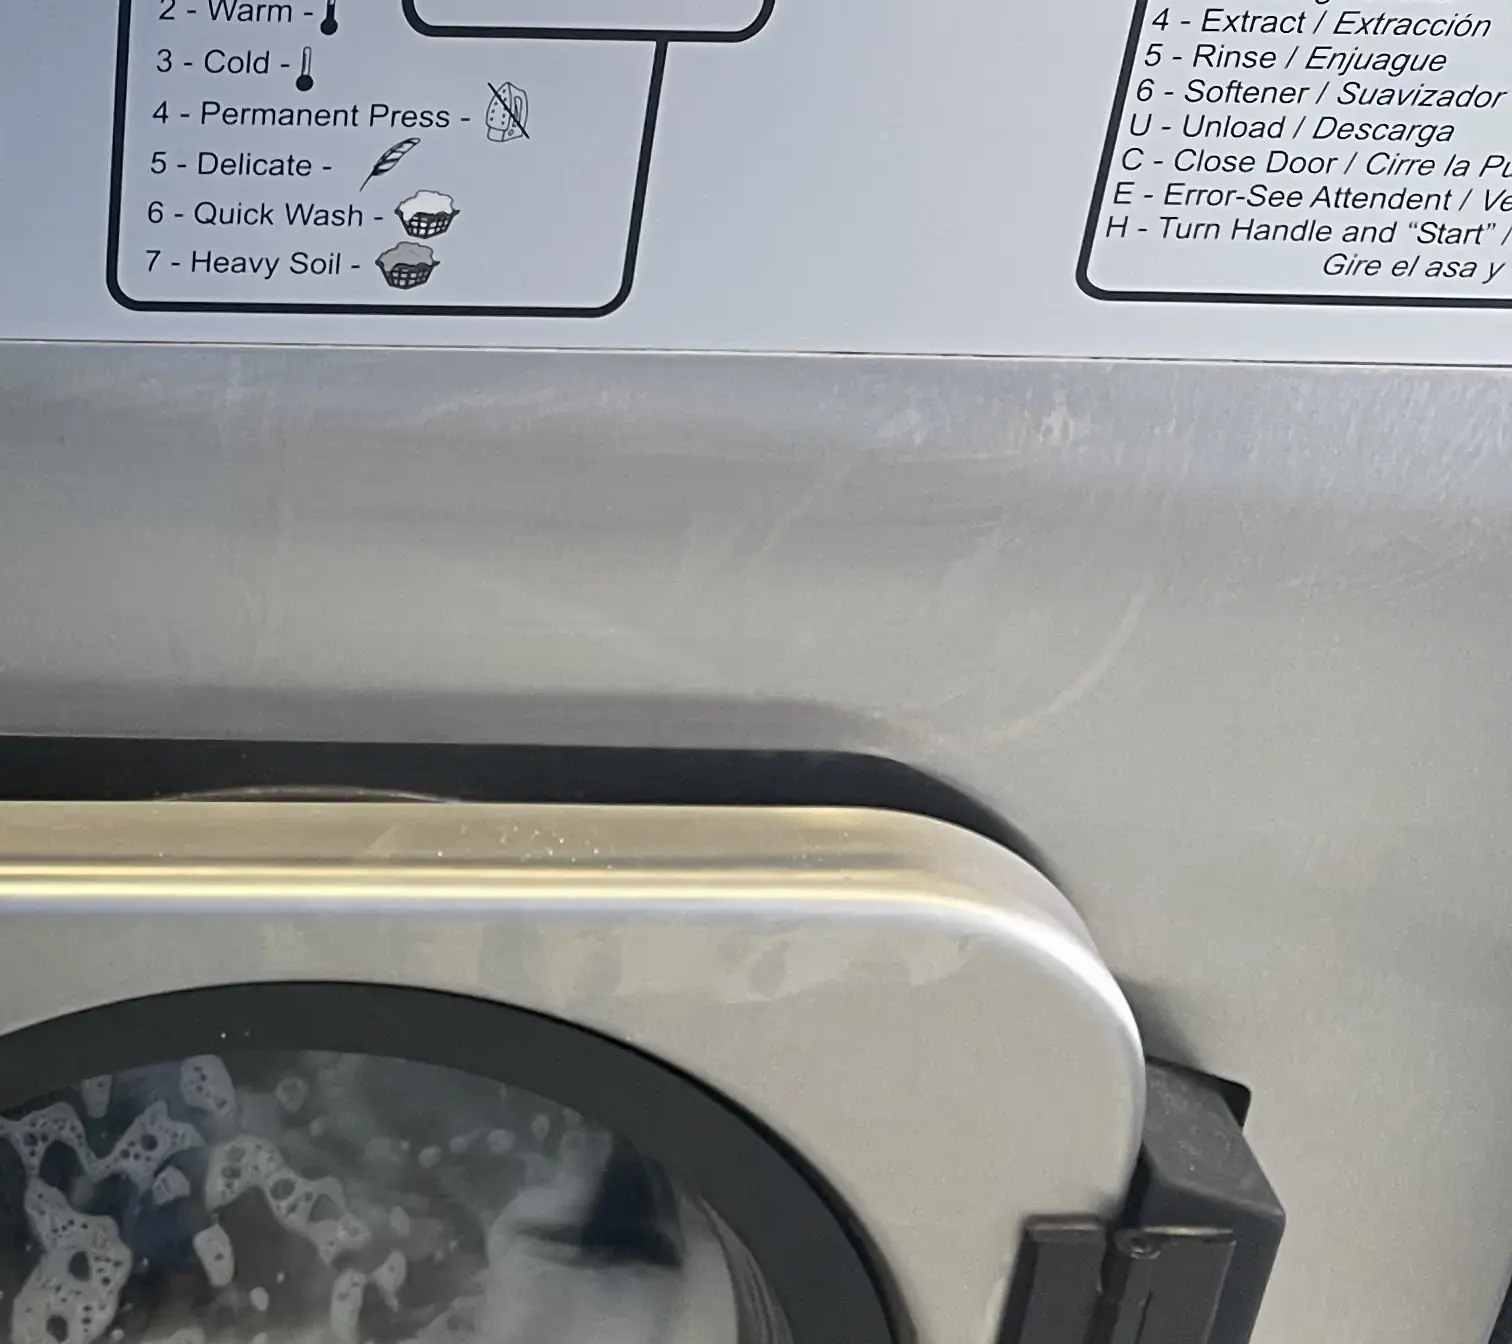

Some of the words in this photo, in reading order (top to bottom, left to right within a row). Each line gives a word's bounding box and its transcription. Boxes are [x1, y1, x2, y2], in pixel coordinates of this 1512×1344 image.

[1152, 8, 1169, 31] 4
[1201, 8, 1306, 34] Extract
[1332, 11, 1491, 38] Extracción
[156, 50, 172, 72] 3
[203, 50, 269, 74] Cold
[1144, 44, 1163, 67] 5
[1192, 44, 1276, 69] Rinse
[1304, 47, 1447, 77] Enjuague
[1136, 78, 1154, 102] 6
[1184, 79, 1310, 104] Softener
[1337, 82, 1507, 108] Suavizador
[152, 101, 169, 123] 4
[200, 102, 359, 127] Permanent
[369, 104, 450, 128] Press
[1130, 114, 1152, 136] U
[1181, 115, 1286, 139] Unload
[1312, 117, 1455, 147] Descarga
[150, 152, 167, 174] 5
[197, 152, 312, 177] Delicate
[1121, 148, 1144, 171] C
[1174, 149, 1256, 173] Close
[1266, 150, 1338, 175] Door
[1365, 152, 1435, 177] Cirre
[1444, 153, 1471, 177] la
[1113, 182, 1135, 204] E
[1163, 183, 1303, 207] Error-See
[1309, 186, 1453, 211] Attendent
[147, 202, 163, 224] 6
[194, 202, 274, 227] Quick
[285, 204, 363, 227] Wash
[1106, 216, 1128, 237] H
[1158, 217, 1220, 240] Turn
[1231, 218, 1332, 242] Handle
[1342, 221, 1398, 244] and
[145, 250, 162, 272] 7
[191, 251, 279, 279] Heavy
[289, 252, 342, 276] Soil
[1322, 253, 1382, 277] Gire
[1390, 255, 1419, 278] el
[1424, 262, 1477, 278] asa
[1483, 262, 1504, 283] y
